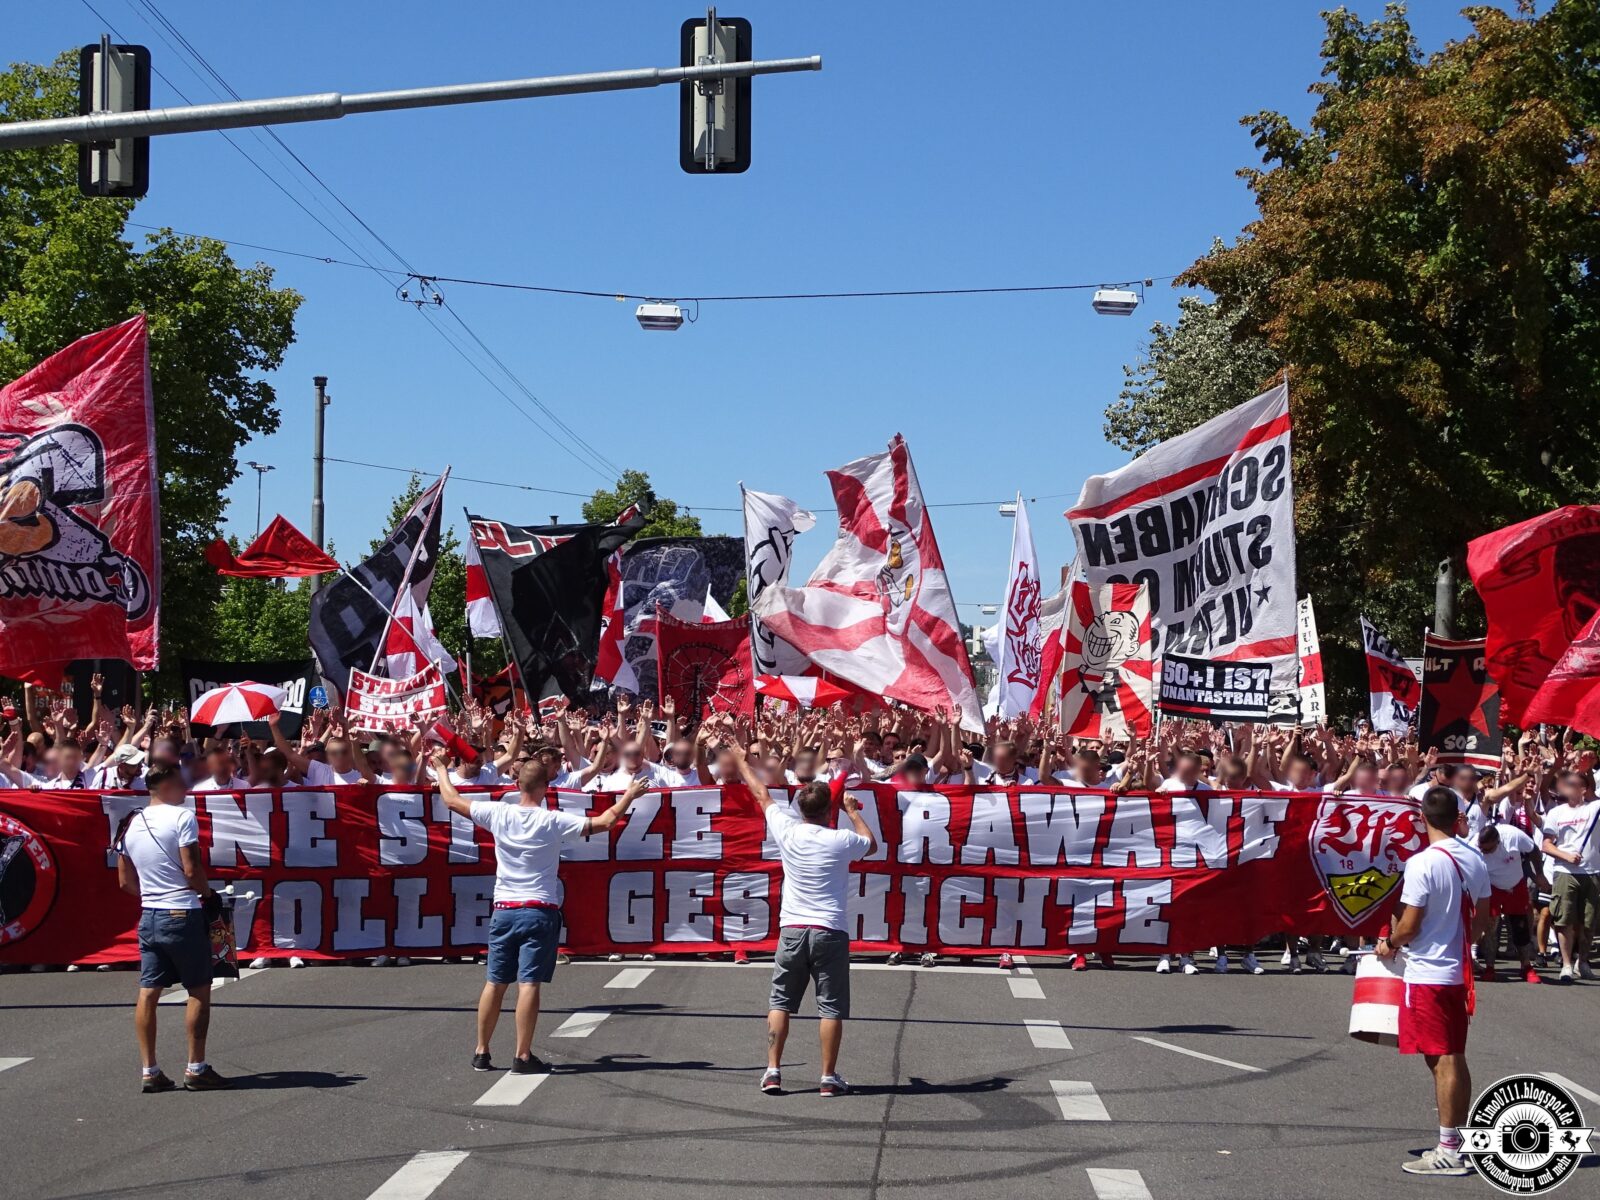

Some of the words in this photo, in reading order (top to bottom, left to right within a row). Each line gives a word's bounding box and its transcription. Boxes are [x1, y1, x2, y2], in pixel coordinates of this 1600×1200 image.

[1163, 659, 1215, 689] 50+1
[1223, 667, 1271, 691] IST
[359, 689, 434, 715] STATT
[1162, 685, 1269, 706] UNANTASTBAR!
[376, 788, 722, 866] STLZE
[1339, 859, 1354, 870] 18
[1387, 863, 1399, 873] 93
[207, 878, 568, 952] VOLLE
[607, 871, 1173, 948] GESHICHTE
